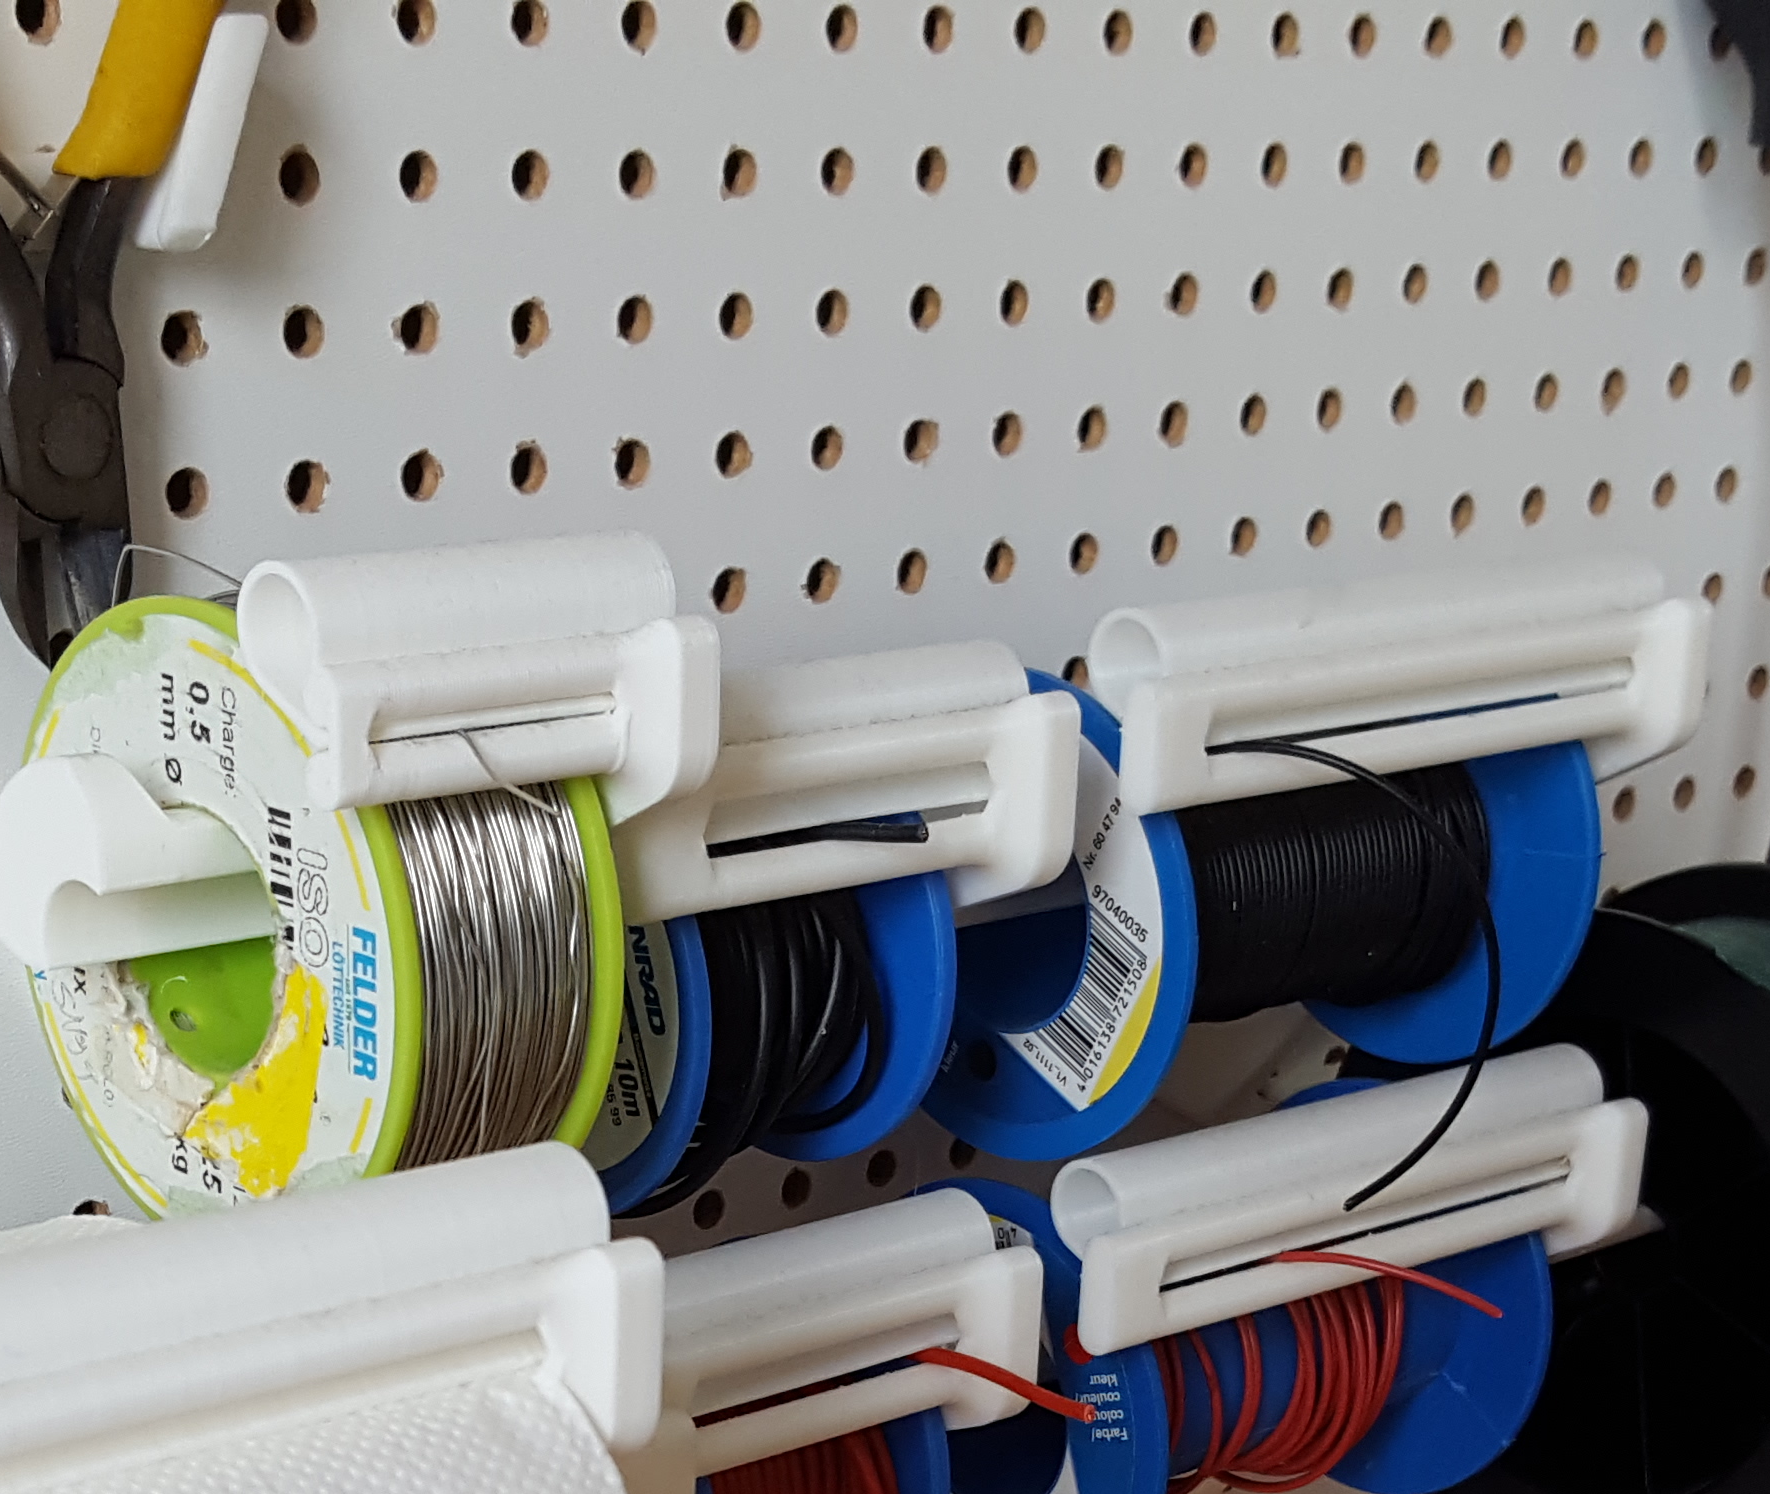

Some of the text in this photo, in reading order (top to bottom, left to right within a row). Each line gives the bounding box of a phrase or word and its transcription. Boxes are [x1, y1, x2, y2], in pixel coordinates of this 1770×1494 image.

[160, 672, 176, 742] mm
[186, 681, 211, 744] 0,5
[219, 686, 238, 799] Charge:
[1082, 851, 1097, 871] Nr.
[1092, 832, 1105, 850] 60
[297, 847, 329, 969] ISO
[1091, 884, 1148, 943] 97040035
[332, 940, 345, 1050] LÖTTECHNIK
[352, 926, 378, 1081] FELDER
[629, 925, 666, 1036] NRAD
[1083, 1021, 1116, 1080] 016138
[1112, 958, 1148, 1019] 721508
[1089, 1373, 1118, 1387] kleur
[1091, 1409, 1124, 1421] colou
[1091, 1427, 1128, 1441] Farbe/
